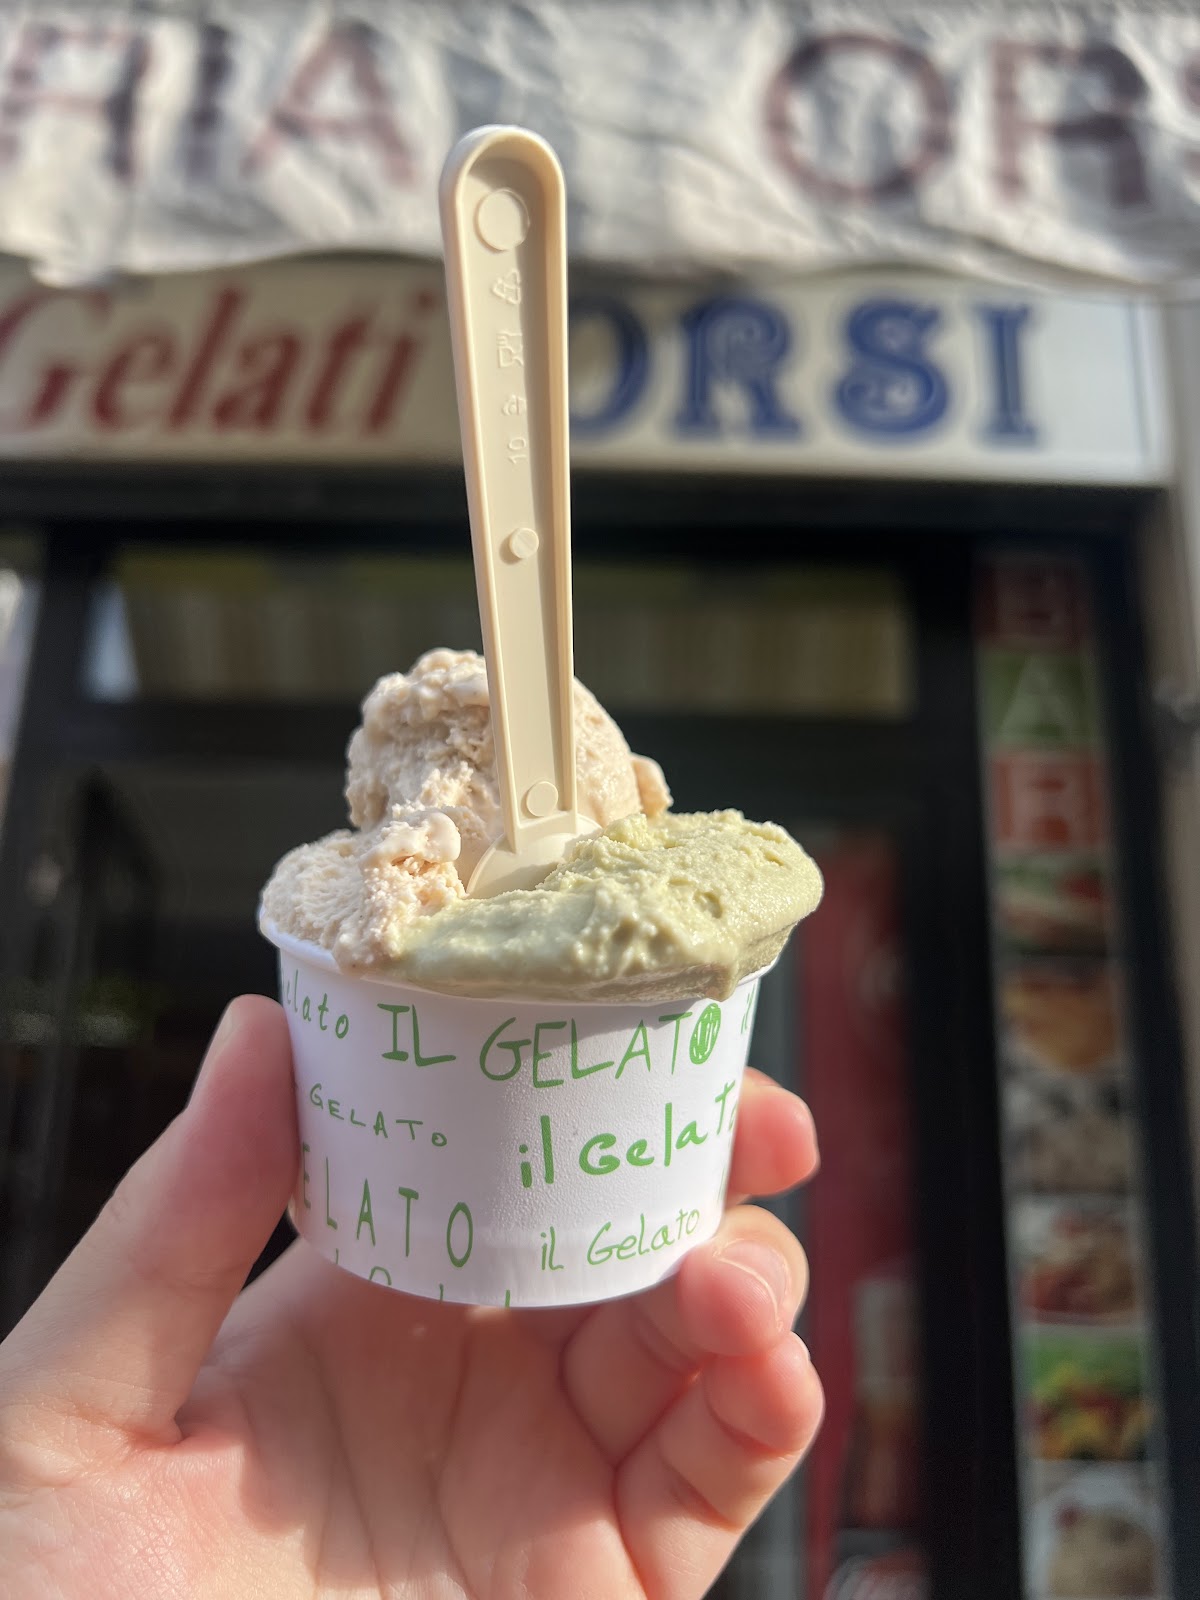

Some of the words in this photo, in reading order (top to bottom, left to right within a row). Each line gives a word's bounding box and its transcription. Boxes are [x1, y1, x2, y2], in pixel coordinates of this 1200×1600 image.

[760, 30, 1200, 210] OR
[0, 284, 440, 438] Gelati
[566, 284, 1038, 448] ORSI
[284, 968, 349, 1039] elato
[377, 1003, 456, 1067] IL
[479, 1002, 722, 1088] GELATO
[309, 1083, 448, 1147] GELATO
[518, 1114, 555, 1188] il
[586, 1208, 701, 1266] Gelato
